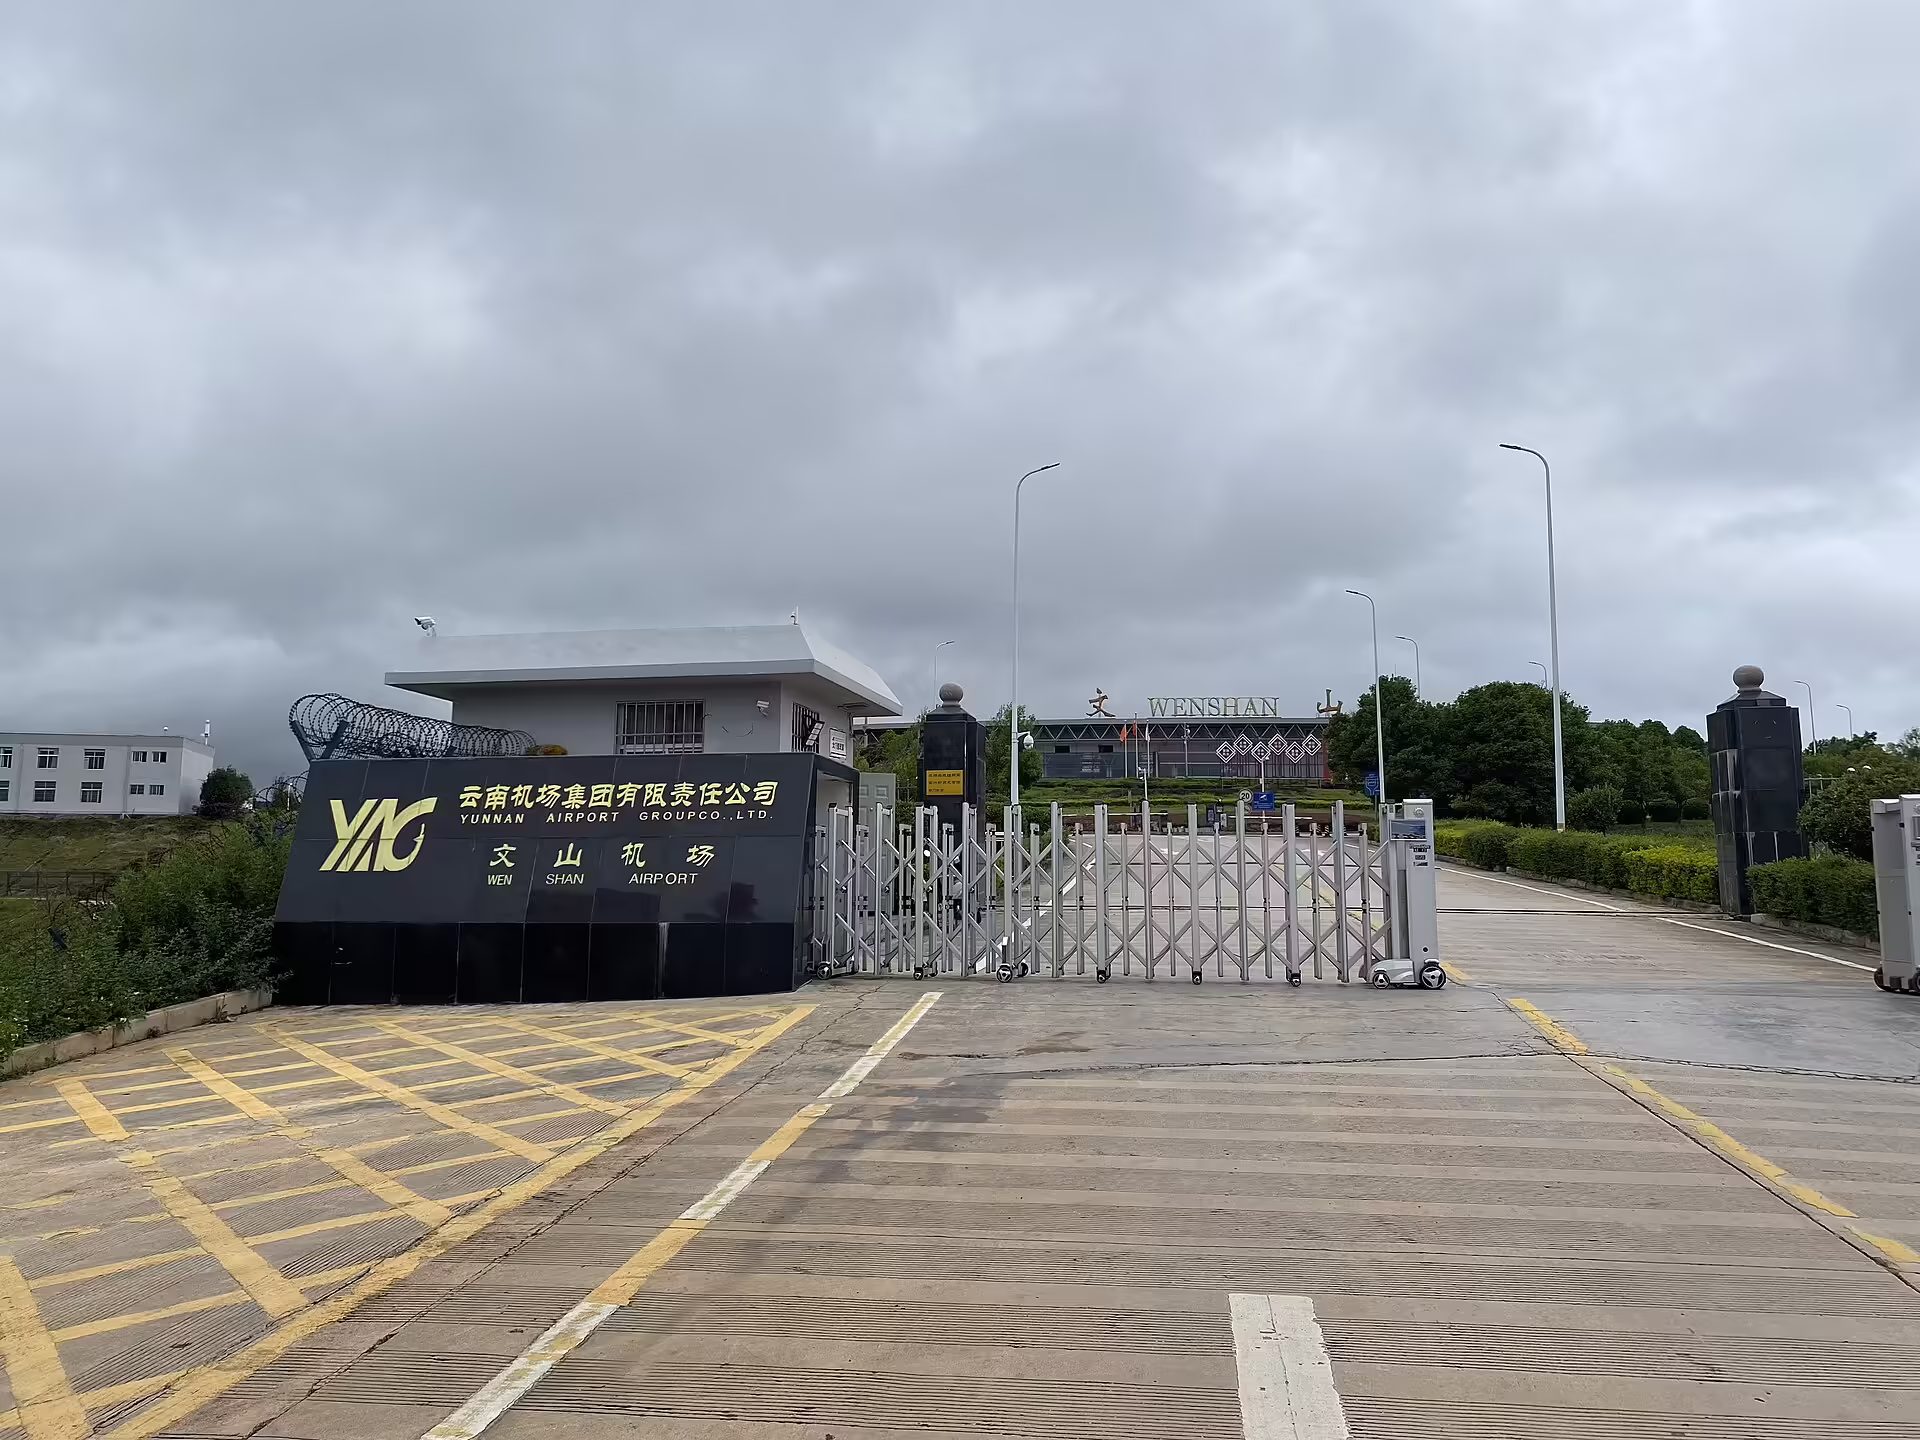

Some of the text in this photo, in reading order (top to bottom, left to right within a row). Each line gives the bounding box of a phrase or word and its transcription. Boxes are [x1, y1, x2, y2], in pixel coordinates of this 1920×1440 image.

[1086, 688, 1116, 718] 文
[1147, 697, 1279, 717] WENSHAN
[1316, 689, 1343, 714] 山
[459, 782, 778, 811] 云南机场集团有限责任公司
[1241, 792, 1250, 800] 20
[460, 813, 524, 824] YUNNAN
[546, 812, 620, 823] AIRPORT
[487, 872, 698, 886] WEN SHAN AIRPORT
